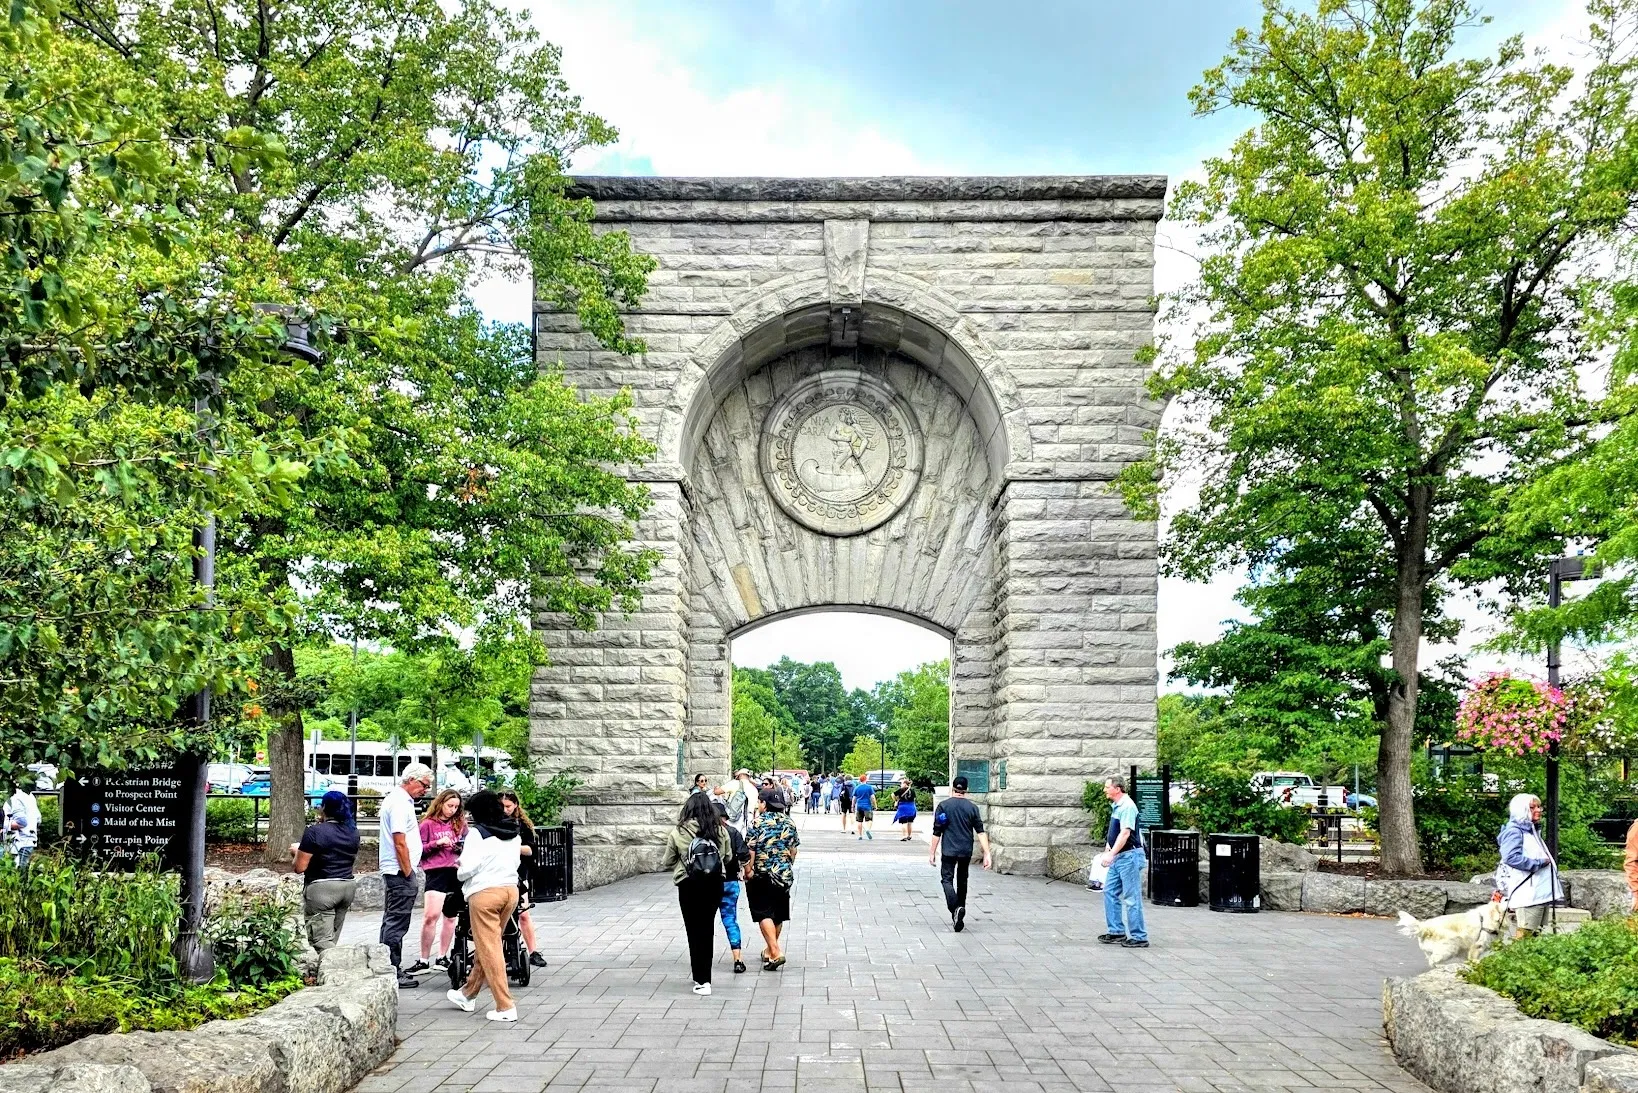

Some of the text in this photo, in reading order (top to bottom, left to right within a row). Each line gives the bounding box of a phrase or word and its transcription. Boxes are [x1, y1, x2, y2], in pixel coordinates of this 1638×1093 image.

[152, 778, 181, 789] Bridge
[115, 790, 152, 800] Prospect
[154, 790, 177, 798] Point
[105, 803, 165, 812] Visitor Center
[104, 817, 175, 826] Maid of the Mist
[145, 835, 168, 844] Point
